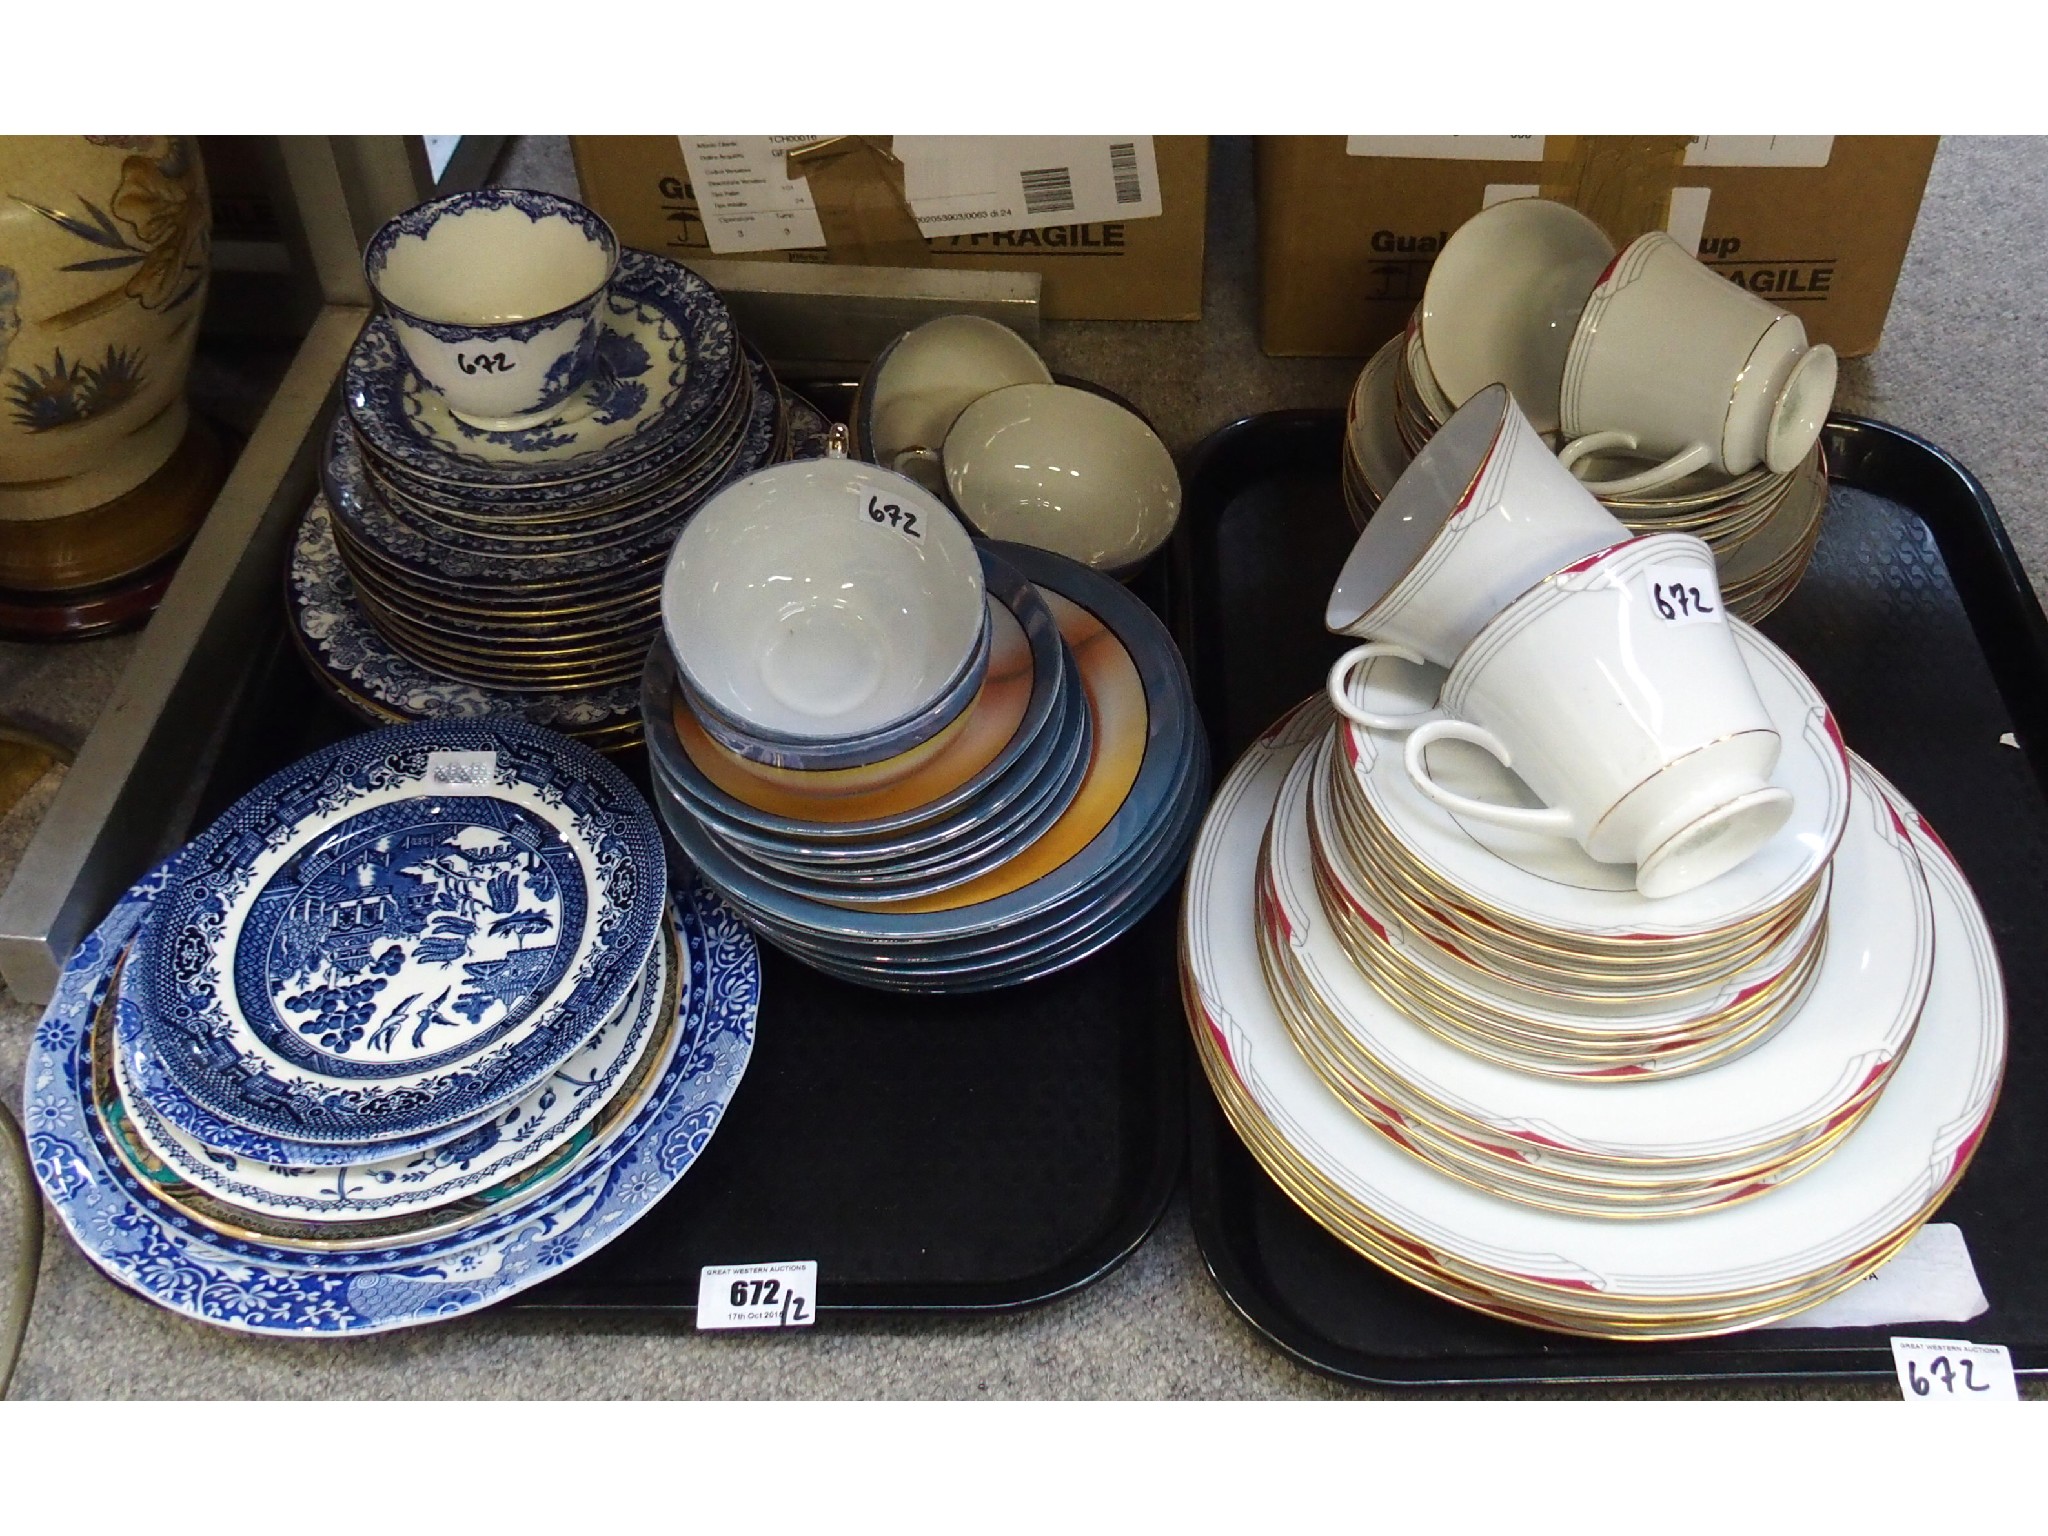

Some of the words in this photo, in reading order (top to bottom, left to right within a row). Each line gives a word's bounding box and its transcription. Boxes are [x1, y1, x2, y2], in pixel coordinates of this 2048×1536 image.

[1698, 237, 1741, 259] up
[1720, 268, 1834, 292] AGILE
[457, 352, 516, 375] 672
[868, 495, 921, 538] 672
[1654, 582, 1714, 621] 672
[733, 1266, 768, 1274] WESTERN
[770, 1264, 807, 1272] AUCTIONS
[1963, 1346, 2000, 1354] AUCTIONS
[1908, 1355, 1991, 1396] 672
